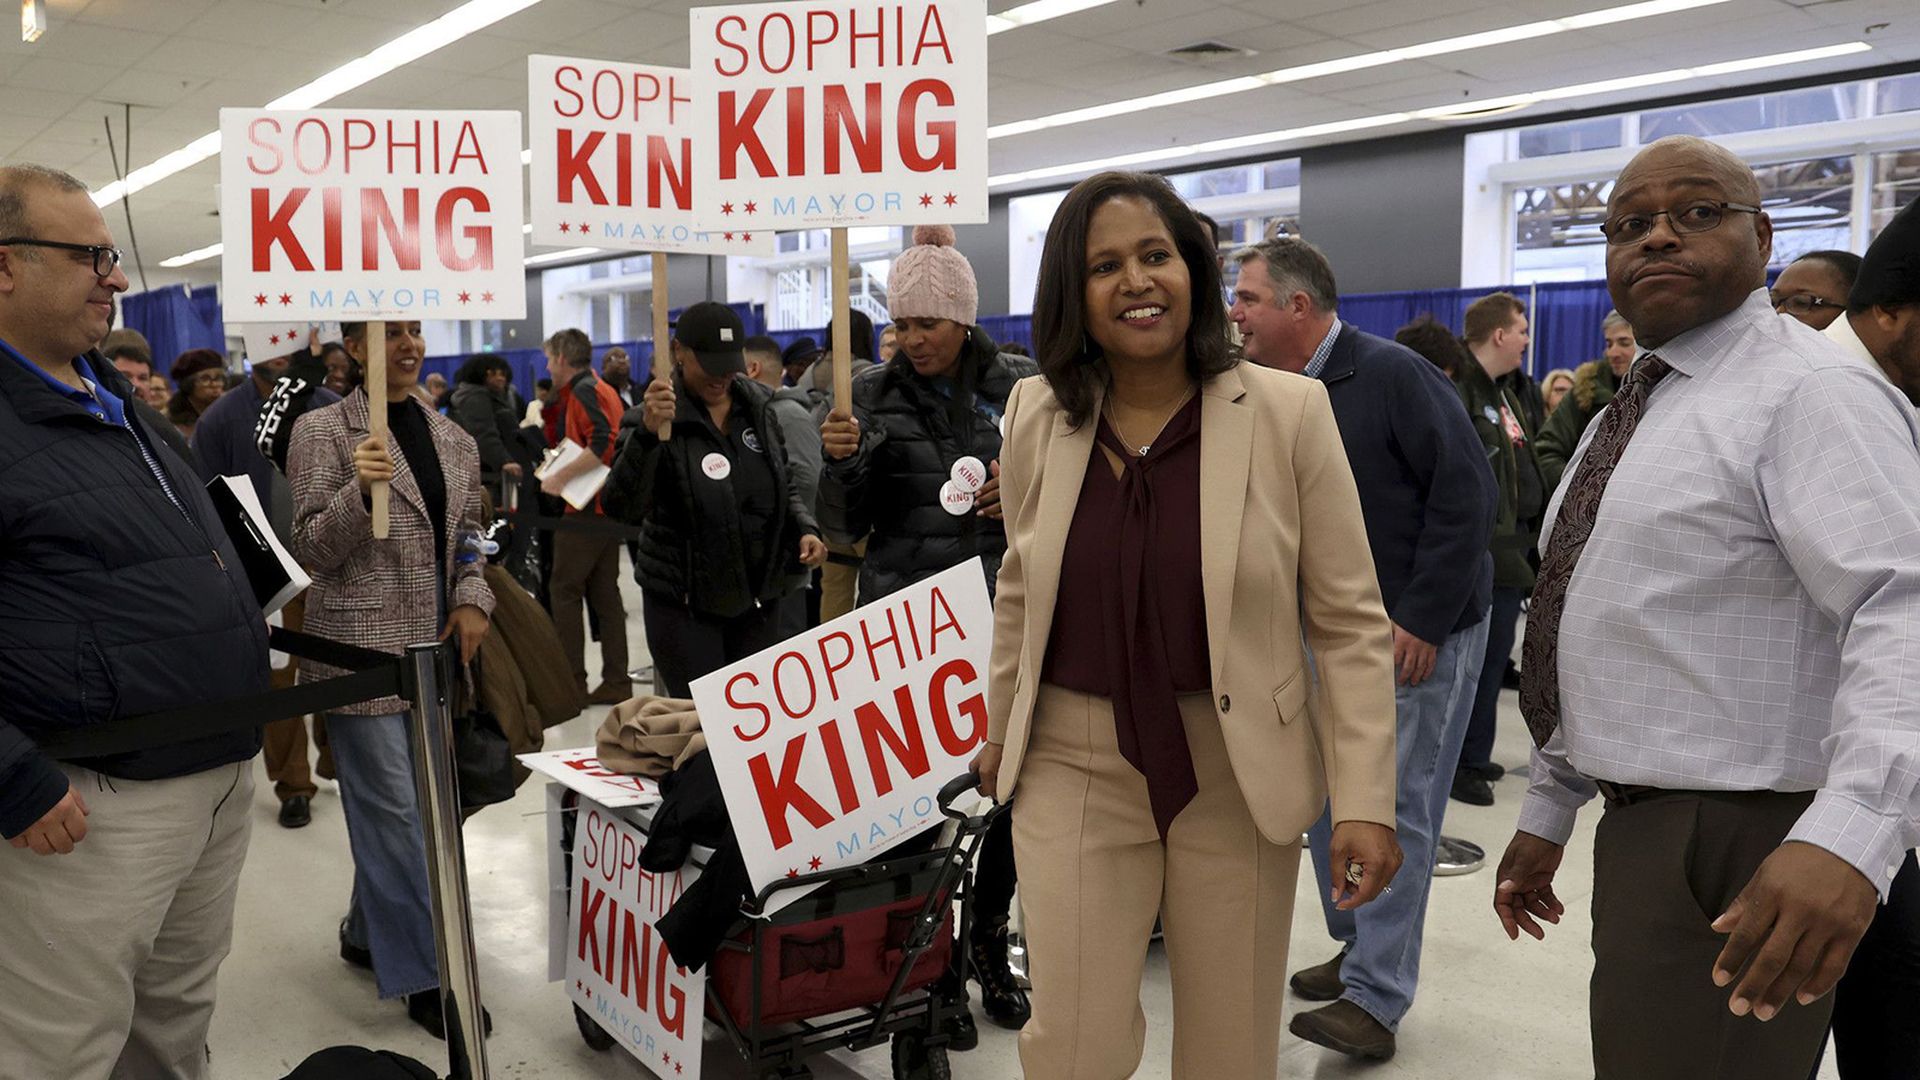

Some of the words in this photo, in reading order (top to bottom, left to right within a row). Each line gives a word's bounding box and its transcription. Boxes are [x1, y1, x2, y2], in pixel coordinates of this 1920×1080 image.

[714, 4, 953, 77] SOPHIA
[554, 66, 691, 125] SOPH
[247, 118, 488, 175] SOPHIA
[718, 79, 957, 180] KING
[557, 128, 692, 211] KIN
[251, 186, 494, 272] KING
[773, 192, 902, 216] MAYOR
[309, 288, 440, 308] MAYOR
[708, 460, 726, 472] KING
[958, 465, 979, 488] KING
[946, 492, 970, 504] KING
[724, 586, 966, 742] SOPHIA
[747, 659, 988, 851] KING
[835, 796, 933, 859] MAYO
[578, 876, 686, 1041] KING
[596, 994, 656, 1057] MAYOR
